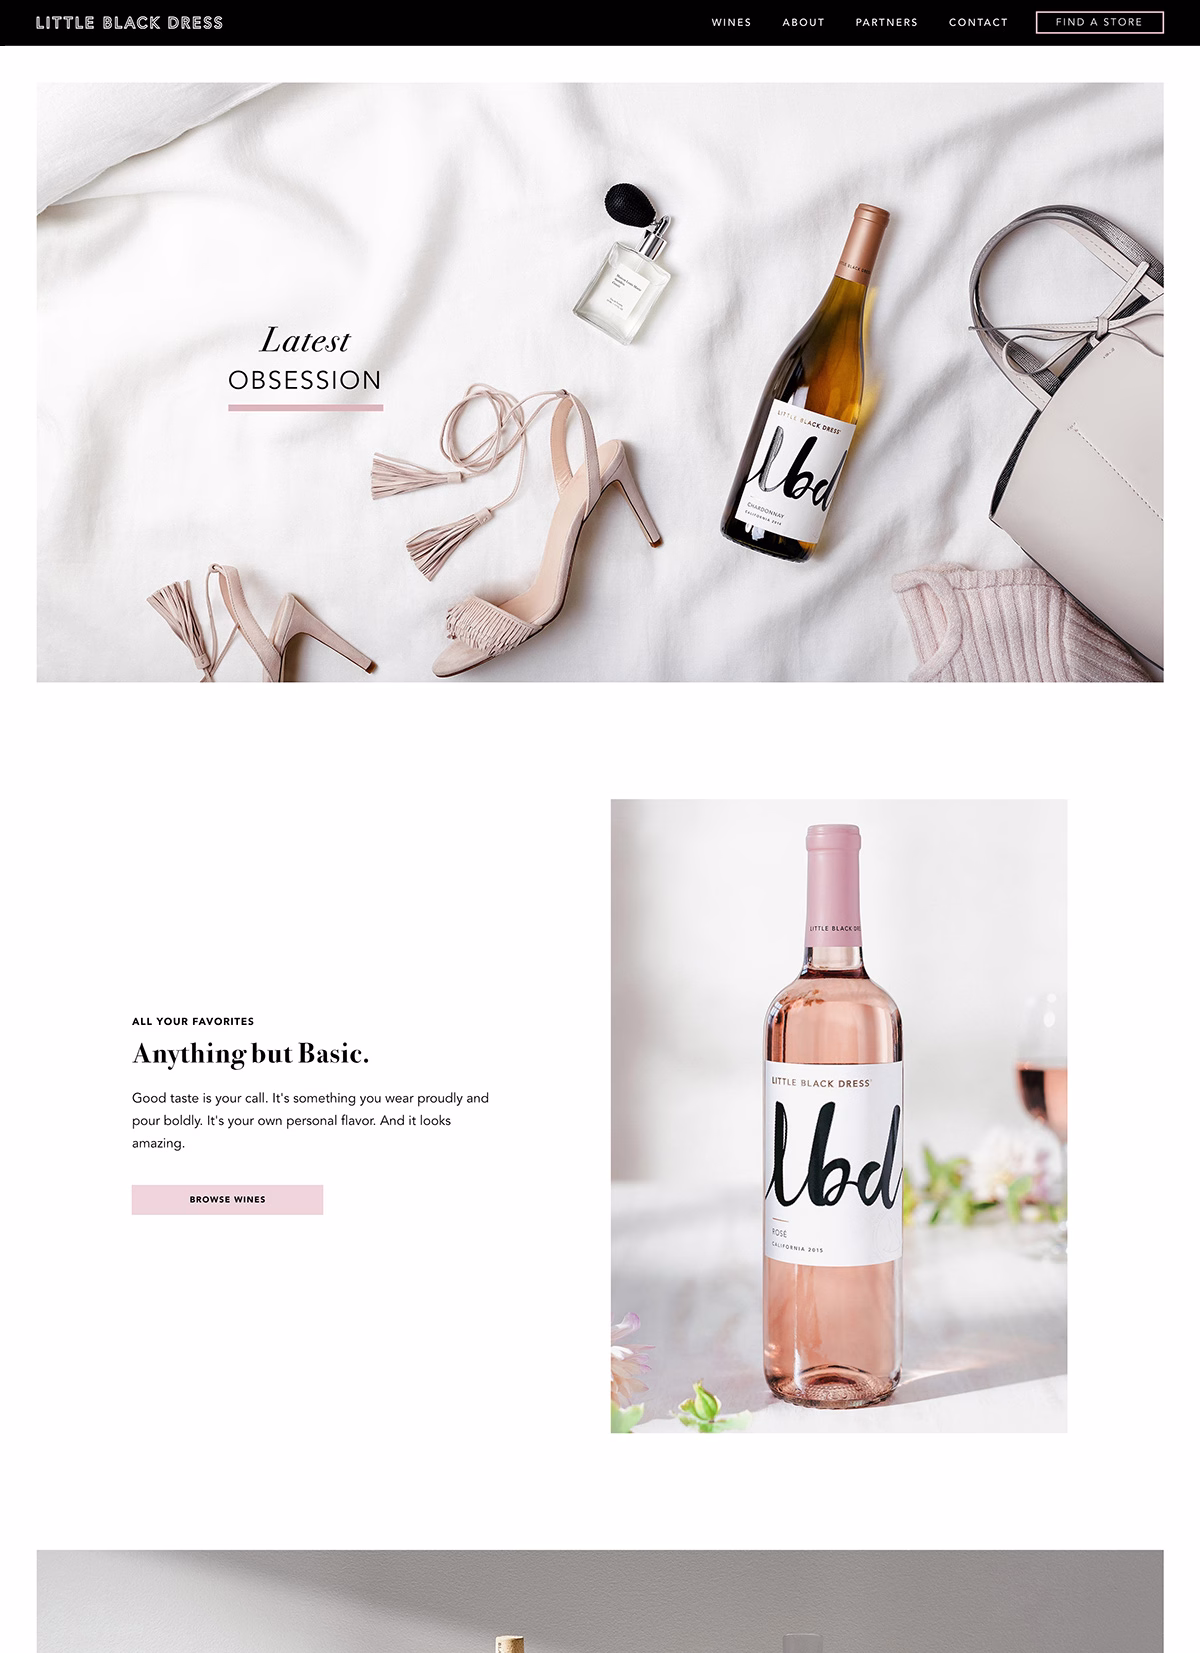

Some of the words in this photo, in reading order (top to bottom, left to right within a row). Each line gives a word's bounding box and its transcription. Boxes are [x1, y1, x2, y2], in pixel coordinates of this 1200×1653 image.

[35, 15, 95, 30] LITTLE
[102, 15, 161, 30] BLACK
[167, 15, 224, 30] DRESS
[711, 17, 751, 27] WINES
[781, 17, 825, 27] ABOUT
[855, 17, 918, 27] PARTNERS
[948, 17, 1008, 27] CONTACT
[1055, 17, 1085, 27] FIND
[1089, 17, 1098, 27] A
[1103, 17, 1142, 27] STORE
[258, 325, 352, 353] Latest
[228, 369, 380, 391] OBSESSION
[776, 409, 798, 422] LITTLE
[799, 417, 821, 430] BLACK
[821, 424, 842, 435] DRESS
[746, 501, 785, 520] CHARDONNAY
[131, 1017, 153, 1026] ALL
[155, 1016, 189, 1026] YOUR
[192, 1016, 255, 1026] FAVORITES
[131, 1041, 248, 1071] Anything
[250, 1041, 294, 1064] but
[298, 1041, 369, 1064] Basic.
[771, 1076, 797, 1087] LITTLE
[800, 1079, 835, 1088] BLACK
[838, 1079, 870, 1088] DRESS
[131, 1091, 167, 1104] Good
[169, 1093, 200, 1104] taste
[202, 1092, 212, 1104] is
[214, 1095, 243, 1107] your
[244, 1091, 269, 1104] call.
[272, 1092, 290, 1104] It's
[292, 1091, 356, 1107] something
[359, 1095, 382, 1107] you
[384, 1095, 415, 1104] wear
[417, 1091, 464, 1107] proudly
[466, 1091, 489, 1104] and
[132, 1117, 161, 1130] pour
[163, 1114, 203, 1130] boldly.
[207, 1114, 225, 1126] It's
[227, 1117, 255, 1130] your
[257, 1117, 283, 1127] own
[286, 1114, 338, 1130] personal
[340, 1113, 376, 1126] flavor.
[379, 1114, 405, 1126] And
[408, 1114, 417, 1126] it
[419, 1114, 452, 1126] looks
[131, 1137, 185, 1152] amazing.
[189, 1195, 231, 1204] BROWSE
[233, 1195, 266, 1204] WINES
